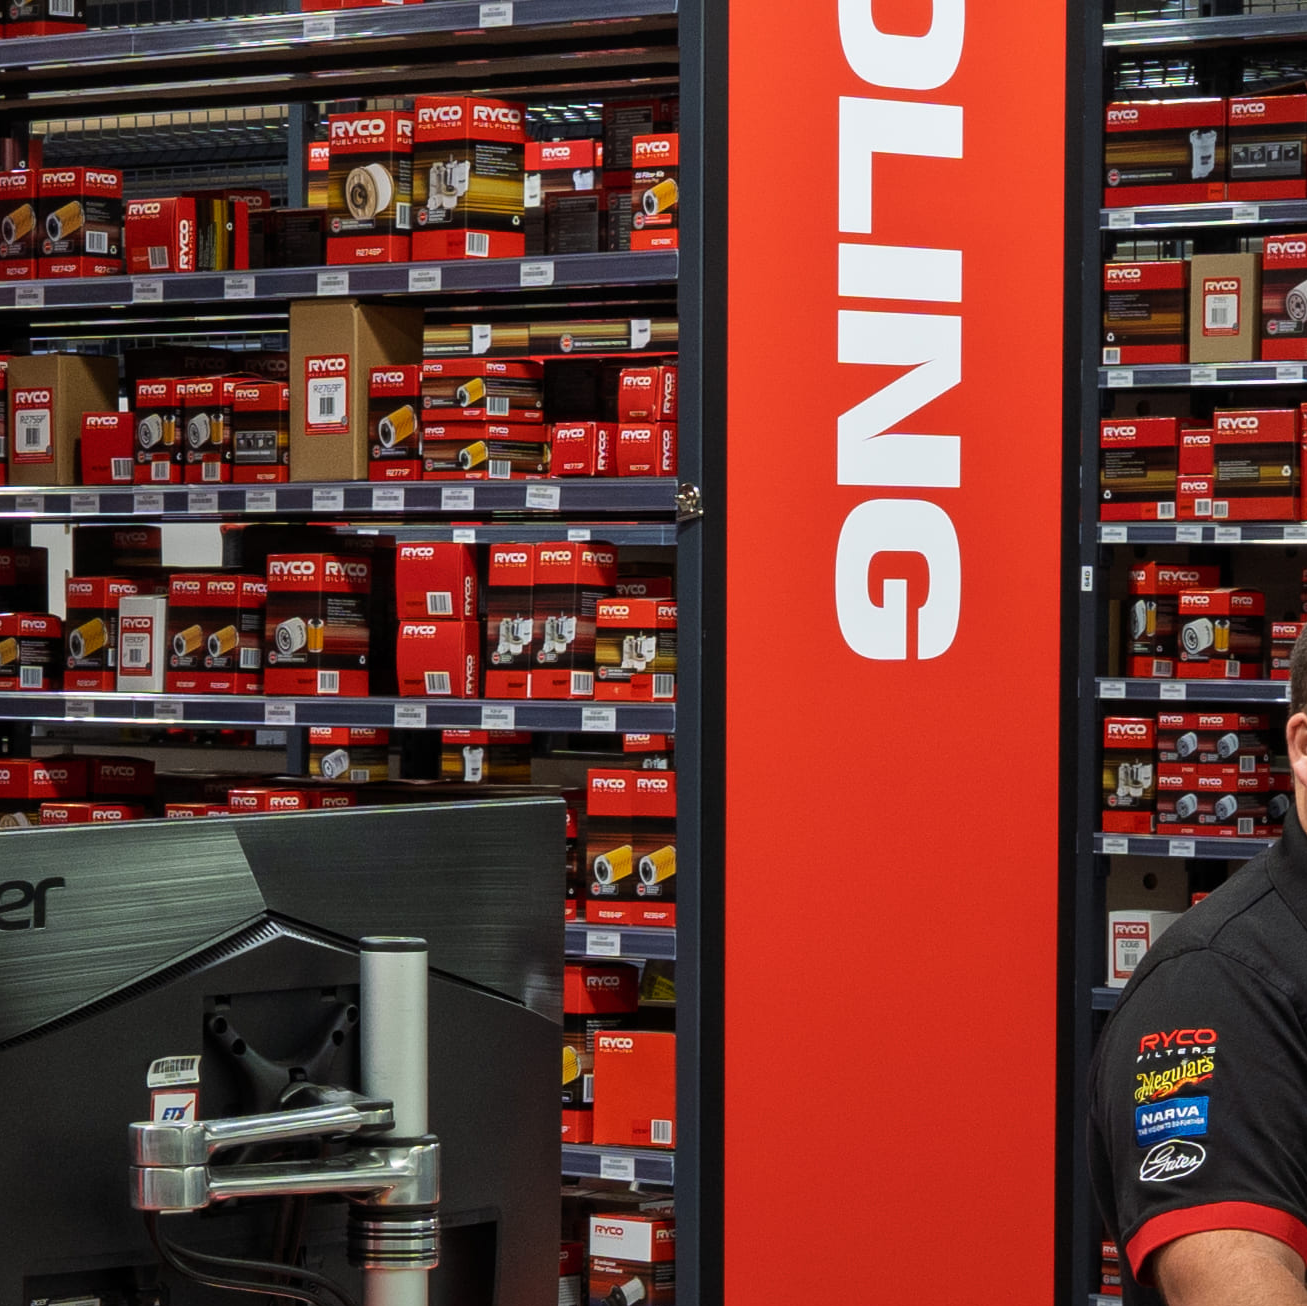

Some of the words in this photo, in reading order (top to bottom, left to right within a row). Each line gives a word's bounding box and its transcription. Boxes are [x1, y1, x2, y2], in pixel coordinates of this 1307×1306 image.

[418, 106, 462, 122] RYCO
[331, 119, 385, 136] RYCO
[1266, 241, 1306, 255] RYCO
[308, 358, 346, 372] RYCO
[15, 391, 50, 404] RYCO
[1217, 417, 1259, 429] RYCO
[400, 547, 434, 558] RYCO
[269, 561, 315, 575] RYCO
[599, 1037, 633, 1049] RYCO
[1140, 1028, 1218, 1053] RYCO
[1141, 1106, 1199, 1125] NARVA
[595, 1225, 623, 1235] RYCO
